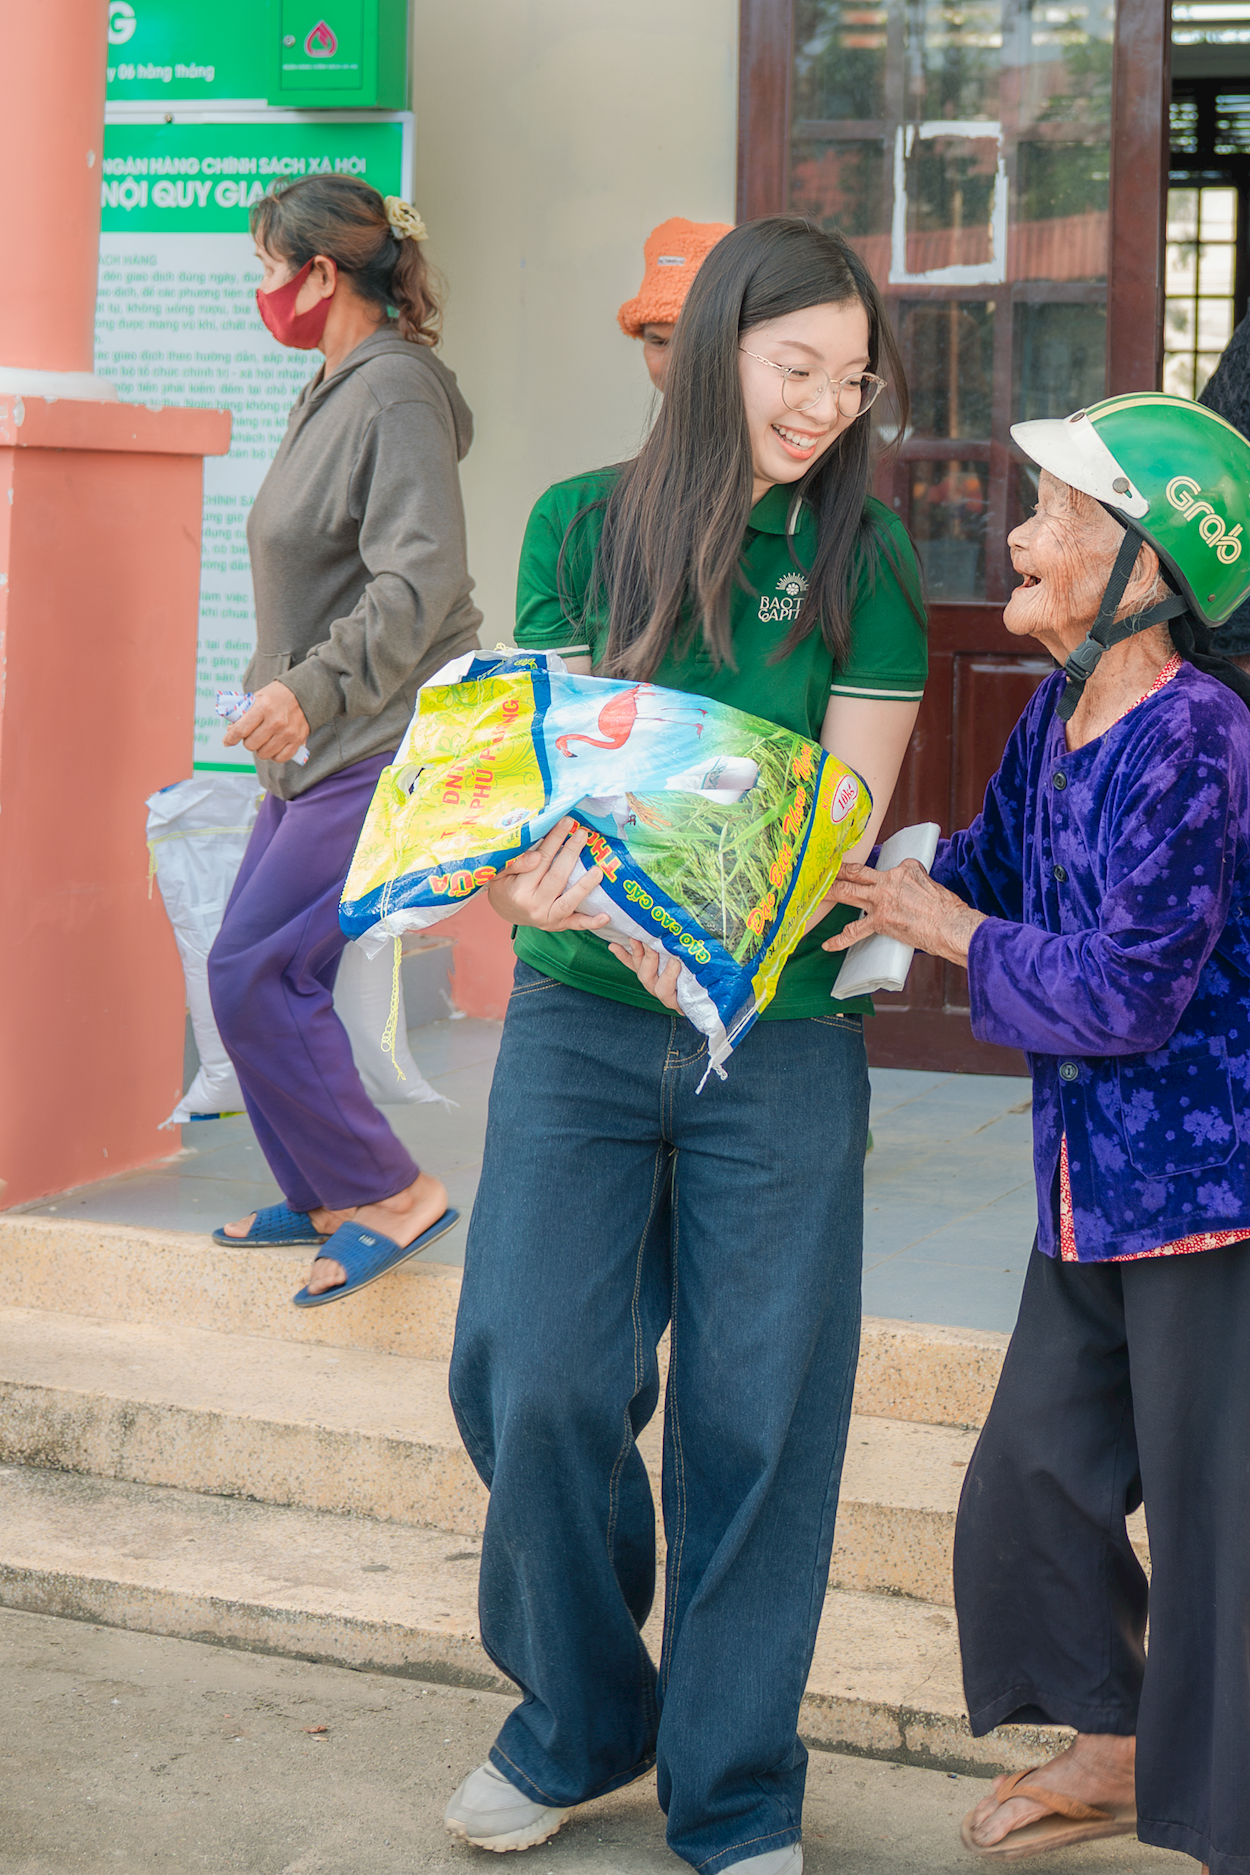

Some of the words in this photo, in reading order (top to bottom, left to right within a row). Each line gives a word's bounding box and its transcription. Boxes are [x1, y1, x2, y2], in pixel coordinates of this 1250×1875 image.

[117, 63, 136, 80] 06
[174, 62, 215, 82] tháng
[102, 155, 148, 175] NGÂN
[150, 155, 200, 175] HÀNG
[201, 156, 257, 175] CHÍNH
[258, 154, 305, 175] SÁCH
[101, 176, 148, 212] NỘI
[151, 180, 213, 208] QUY
[126, 273, 149, 284] giao
[152, 272, 174, 283] dịch
[178, 271, 206, 284] đúng
[179, 288, 220, 300] phương
[127, 302, 162, 315] không
[118, 319, 145, 331] được
[149, 321, 180, 332] mang
[114, 351, 137, 363] giao
[141, 350, 165, 362] dịch
[168, 351, 193, 361] theo
[196, 350, 232, 363] hướng
[121, 365, 136, 379] bộ
[153, 365, 180, 377] chức
[182, 366, 215, 378] chính
[246, 400, 281, 414] không
[1165, 475, 1244, 565] Grab
[470, 768, 494, 810] PHÚ
[429, 866, 498, 898] SỮA
[747, 892, 776, 936] Đặc
[769, 841, 793, 889] Biệt
[622, 879, 654, 910] CẤP
[651, 906, 683, 937] CAO
[679, 933, 711, 965] GẠO
